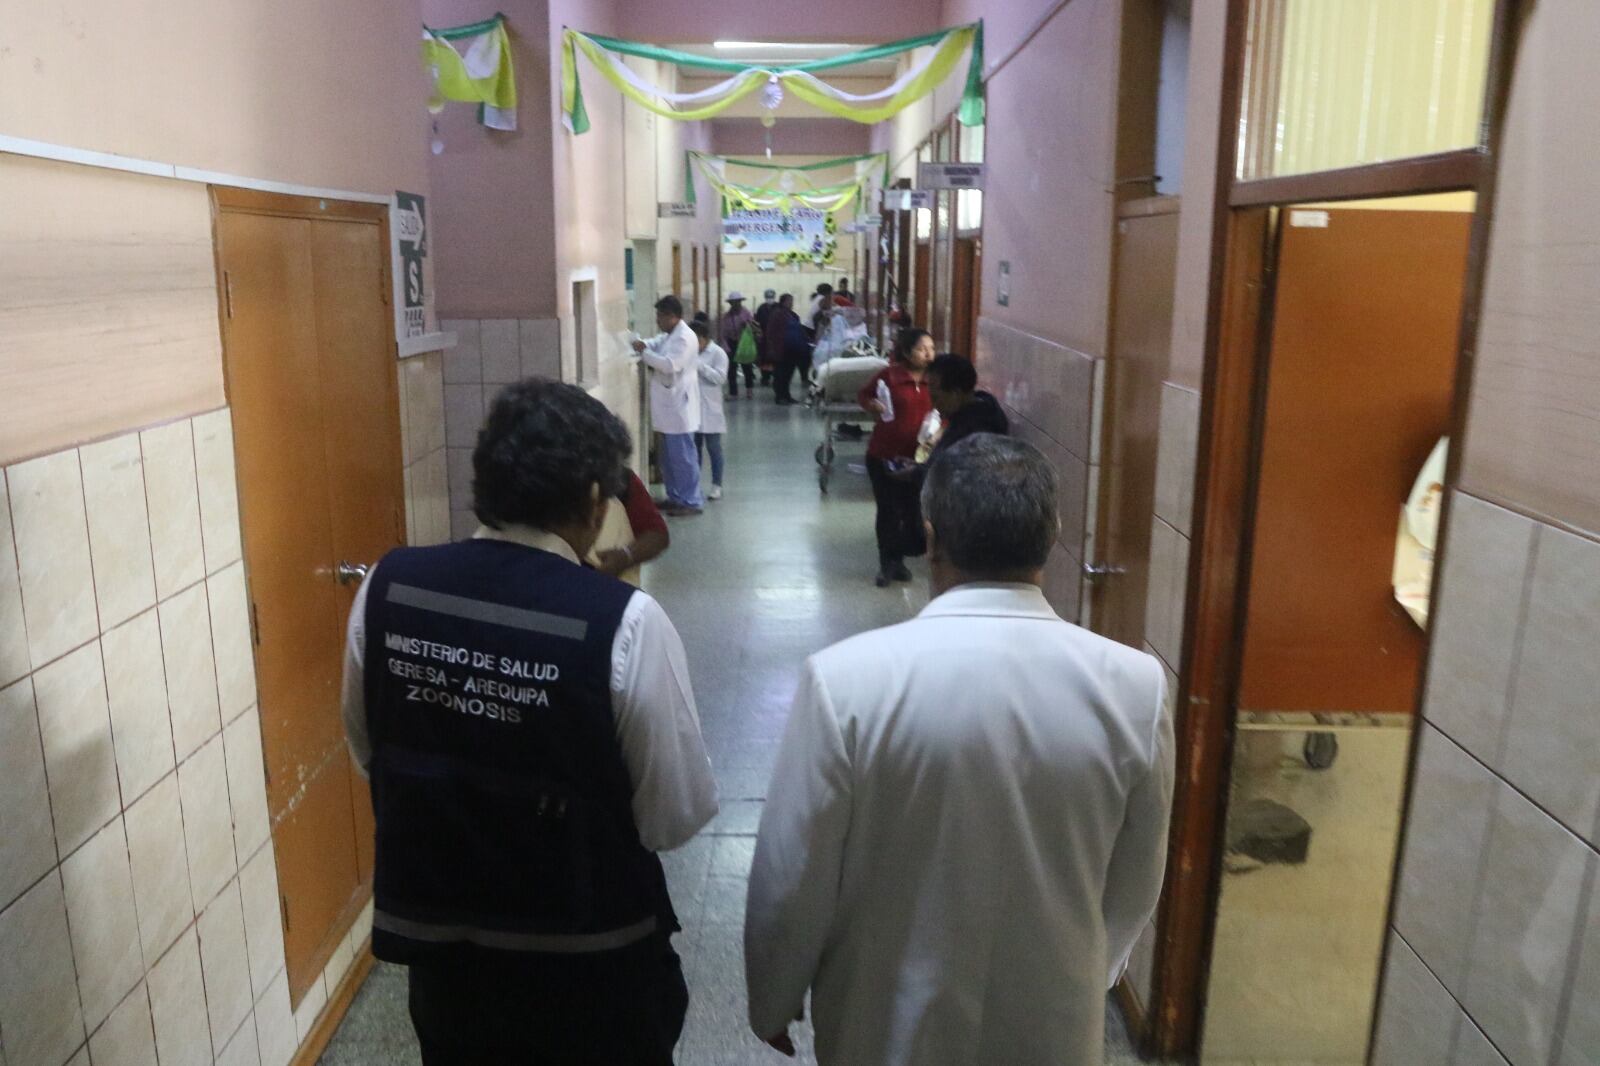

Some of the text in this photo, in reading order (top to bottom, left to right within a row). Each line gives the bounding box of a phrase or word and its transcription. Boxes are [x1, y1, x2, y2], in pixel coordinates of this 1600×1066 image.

[737, 223, 804, 233] MERGENIA
[409, 261, 419, 303] S
[384, 631, 560, 681] MINISTERIO DE SALUD
[387, 657, 448, 687] GERESA
[463, 675, 550, 707] AREQUIPA
[406, 684, 522, 723] ZOONOSIS
